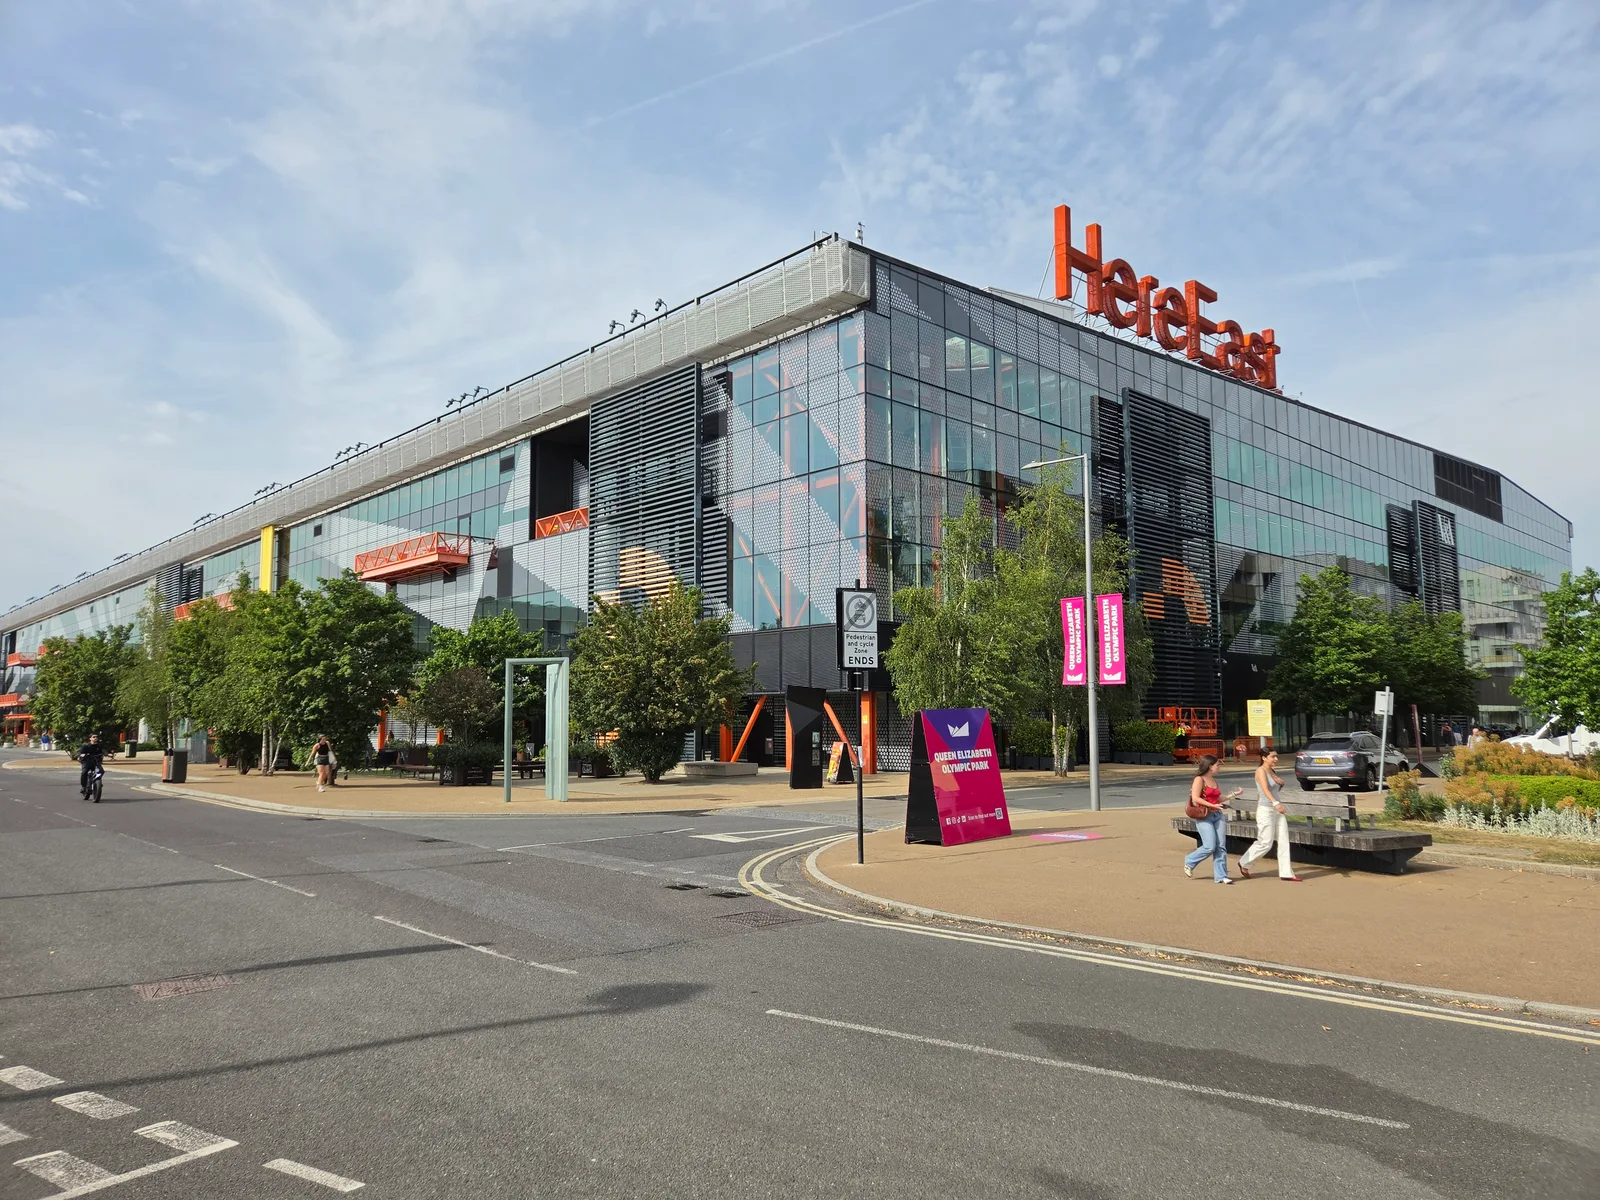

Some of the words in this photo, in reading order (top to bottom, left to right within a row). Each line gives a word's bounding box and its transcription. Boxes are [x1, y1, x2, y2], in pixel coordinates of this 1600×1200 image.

[1066, 602, 1075, 643] ELIZABETH
[1102, 599, 1111, 642] ELIZABETH
[846, 633, 876, 641] Pedestrian
[848, 656, 874, 665] ENDS
[934, 751, 957, 763] QUEEN
[957, 748, 992, 760] ELIZABETH
[942, 762, 971, 774] OLYMPIC
[971, 760, 989, 771] PARK
